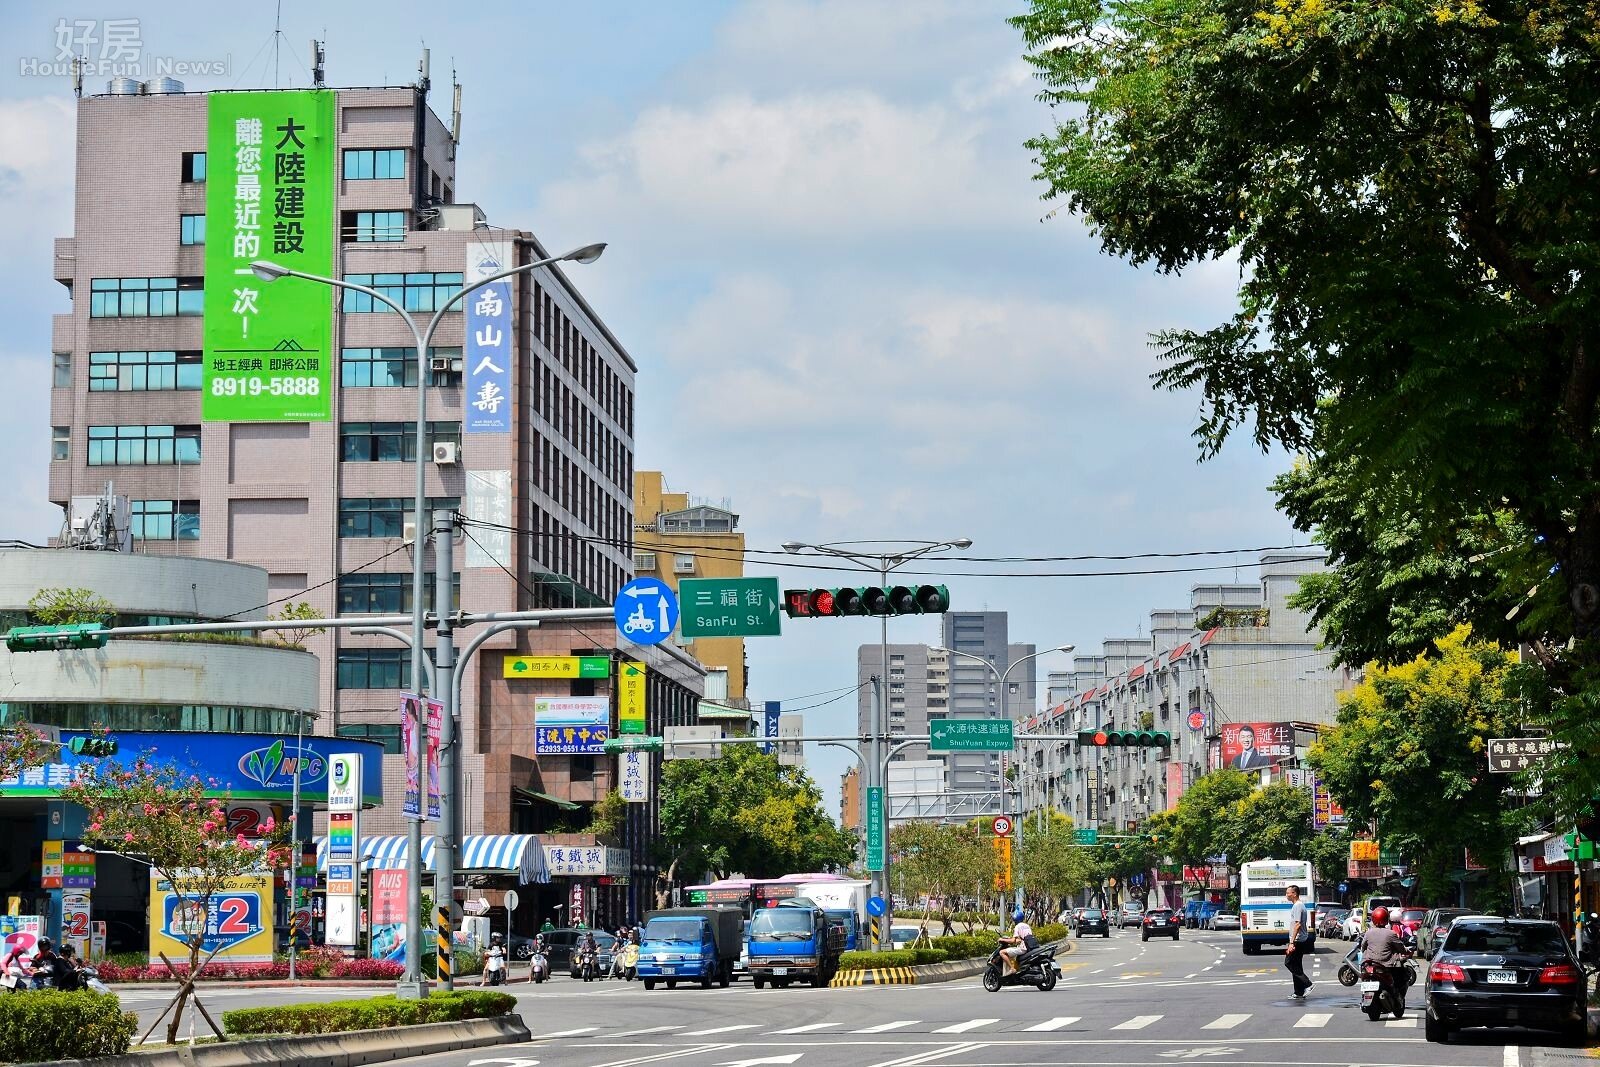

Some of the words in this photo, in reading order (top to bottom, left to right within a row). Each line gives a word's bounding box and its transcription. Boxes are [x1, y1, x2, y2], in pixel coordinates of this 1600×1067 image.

[273, 117, 306, 254] 大陸建設
[471, 288, 505, 414] 南山人壽
[213, 358, 263, 371] 地王經典
[269, 358, 319, 371] 即將公開
[211, 377, 320, 396] 8919-5888
[696, 588, 763, 607] 三福街
[696, 615, 737, 627] SanFu
[746, 614, 764, 626] St.
[531, 662, 571, 672] 國泰人壽
[627, 680, 637, 715] 國泰人壽
[945, 723, 1010, 734] 水源快速道路
[949, 739, 983, 747] ShuiYuan
[986, 739, 1011, 748] Expwy.
[280, 757, 322, 777] NPC
[996, 822, 1008, 830] 50
[550, 848, 601, 864] 陳鐵誠
[377, 873, 403, 889] AVIS
[71, 912, 89, 936] 2
